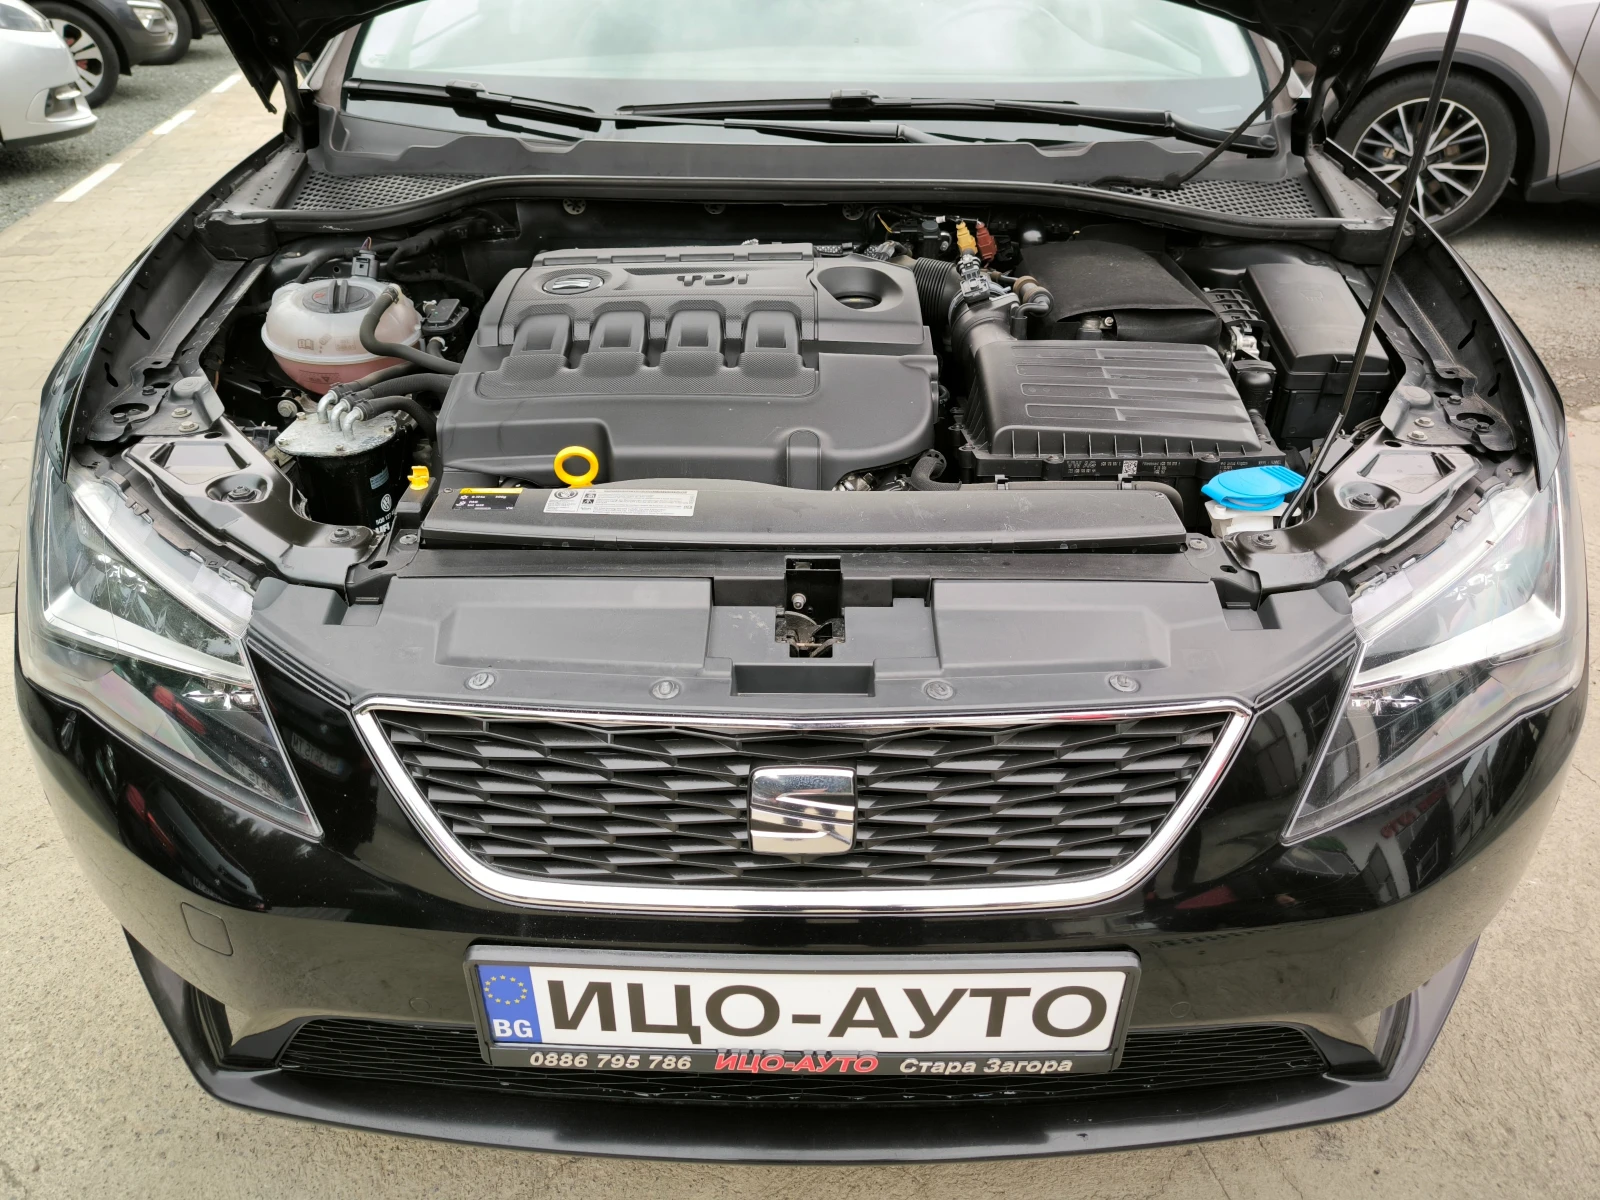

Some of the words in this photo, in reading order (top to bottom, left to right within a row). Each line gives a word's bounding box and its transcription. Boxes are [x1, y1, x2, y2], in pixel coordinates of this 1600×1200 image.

[676, 272, 749, 287] TDI
[547, 980, 1107, 1044] ИЦО-АУТО
[493, 1019, 533, 1038] BG
[529, 1051, 589, 1067] 0886
[597, 1053, 641, 1069] 795
[648, 1055, 693, 1070] 786
[714, 1052, 879, 1073] ИЦО-АУТО
[900, 1058, 977, 1075] Стара
[983, 1059, 1073, 1075] Загора
